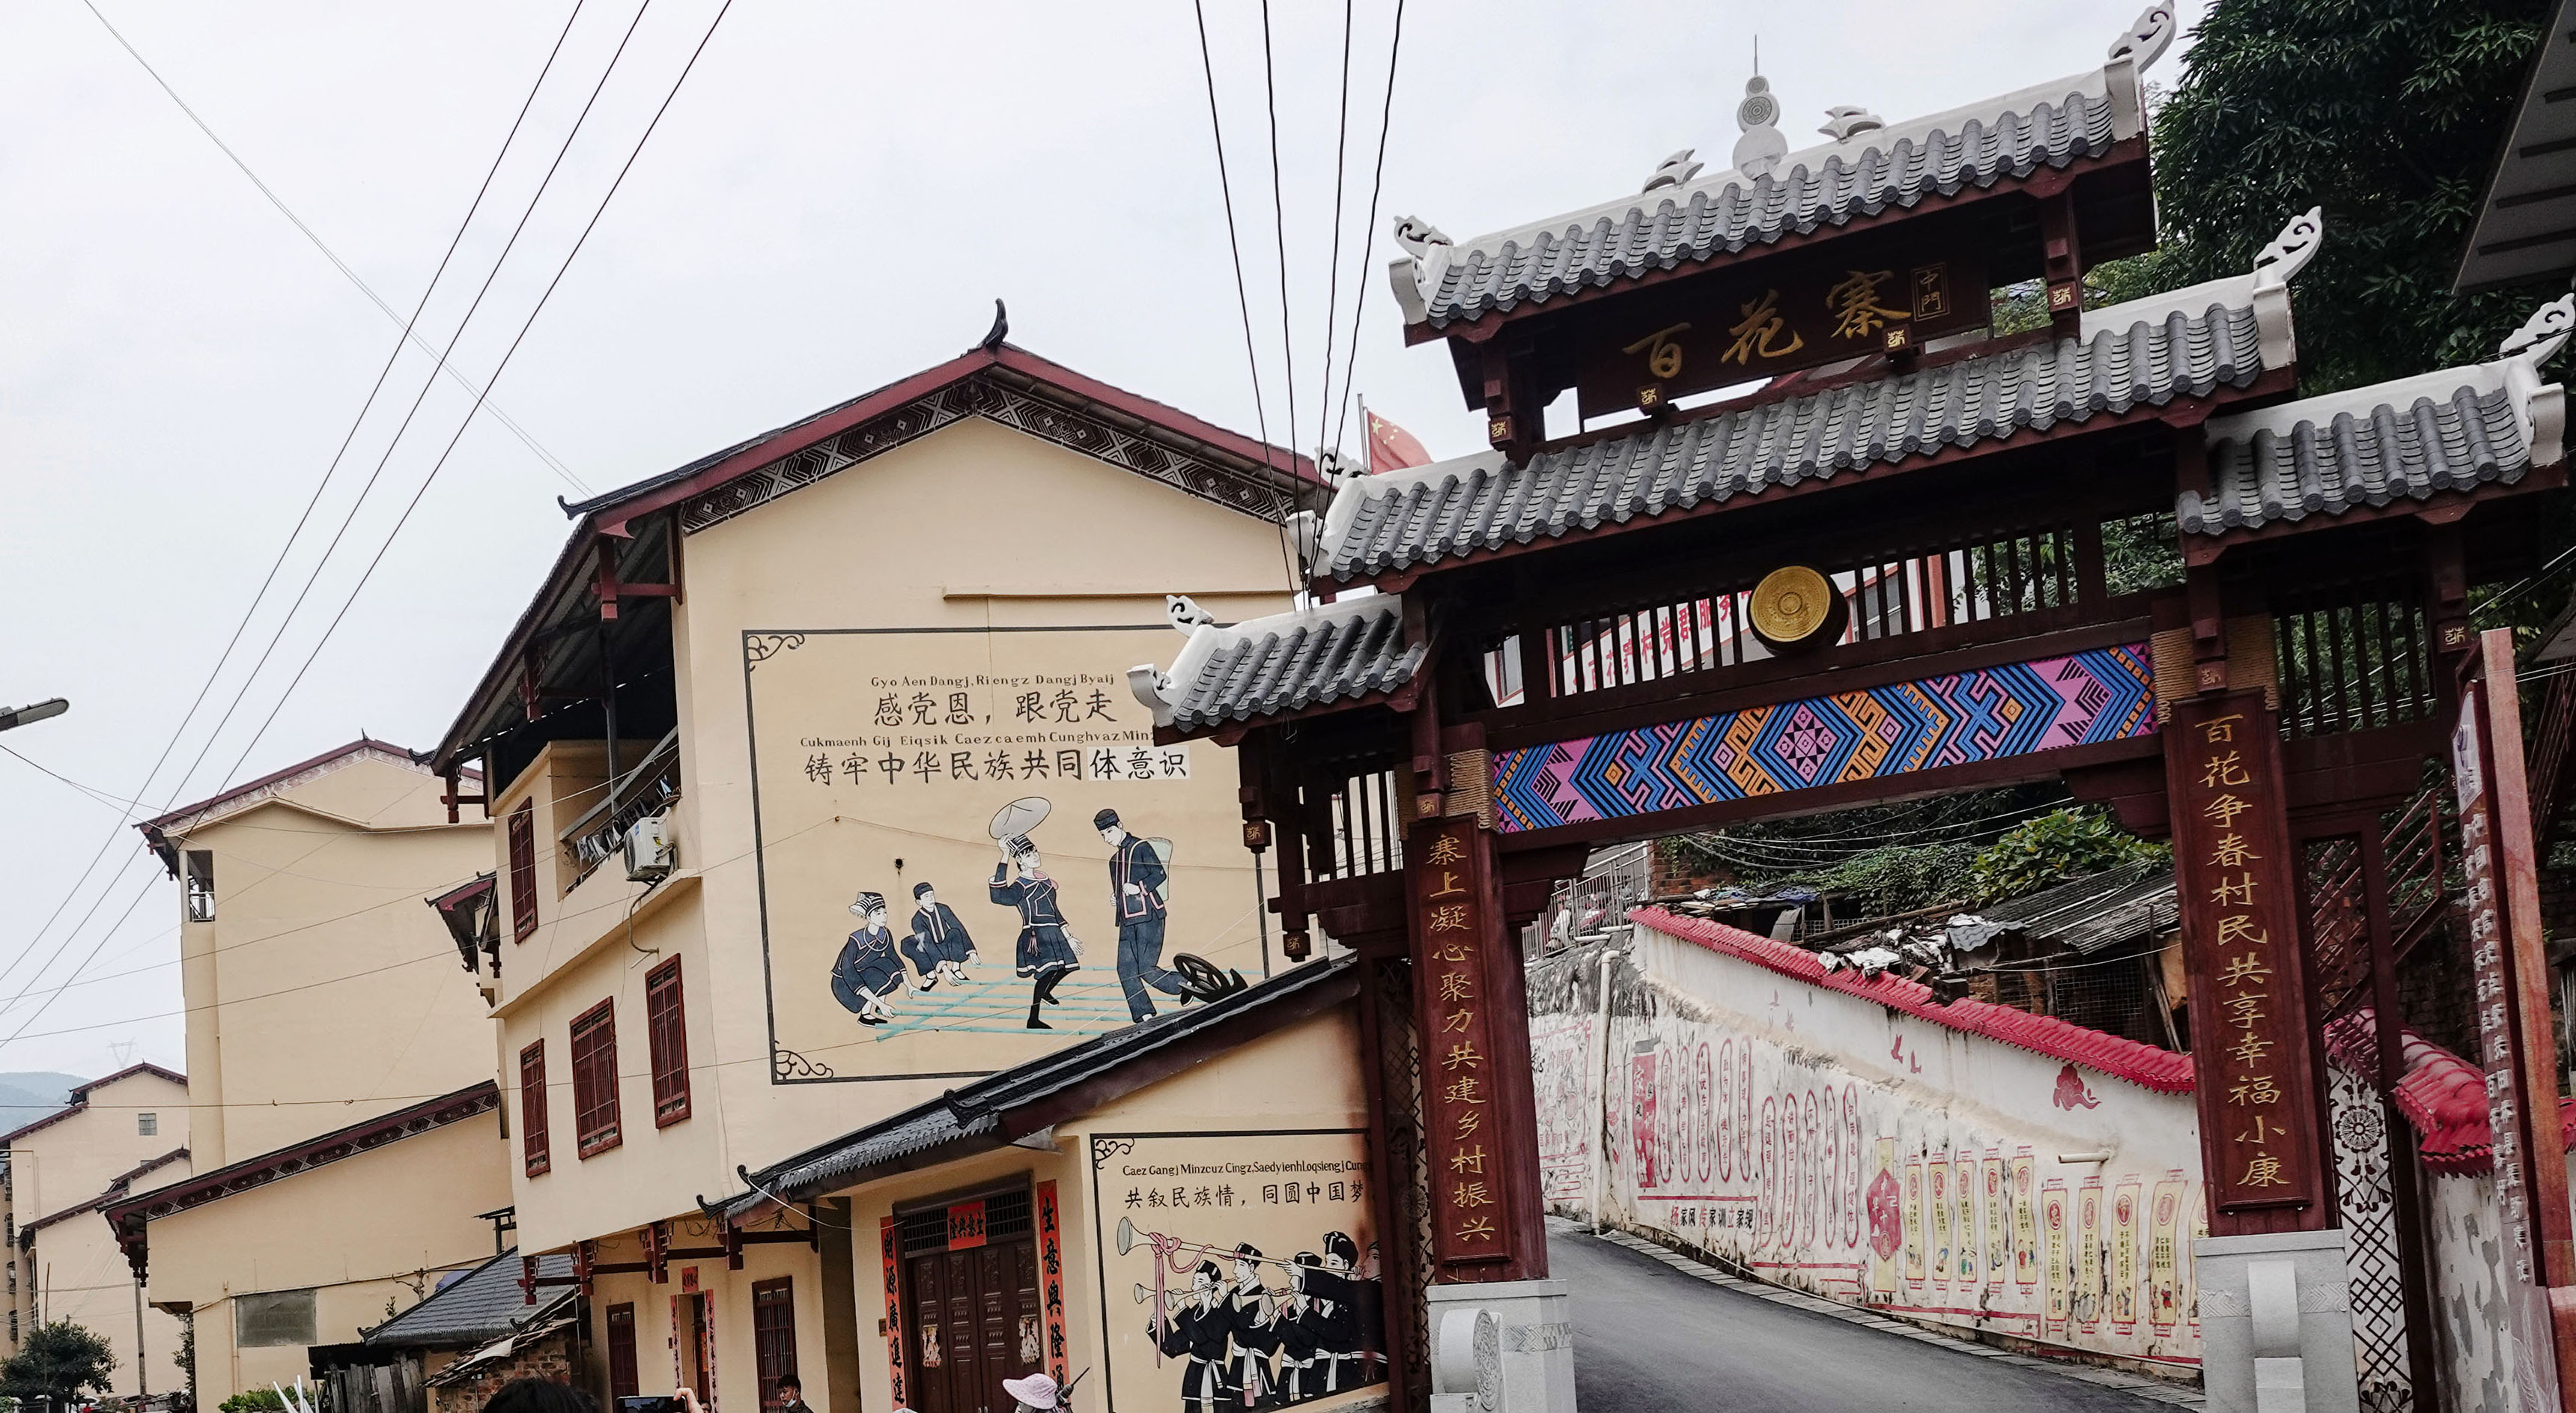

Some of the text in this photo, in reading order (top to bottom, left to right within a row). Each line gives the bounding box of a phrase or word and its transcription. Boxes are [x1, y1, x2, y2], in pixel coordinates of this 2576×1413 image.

[1623, 270, 1912, 379] 百花寨
[871, 676, 898, 687] Gyo
[902, 676, 926, 687] Aen
[1036, 674, 1077, 685] Dangj
[800, 736, 867, 747] Cukmaenh
[873, 735, 891, 748] Gij
[804, 746, 1187, 786] 铸牢中华民族共同体意识
[2194, 713, 2291, 1188] 百花争春村民共享幸福小康
[1425, 833, 1496, 1242] 寨上凝心聚力共建乡村振兴
[1123, 1165, 1146, 1176] Caez
[1124, 1179, 1364, 1209] 共叙民族情，同圆中国梦
